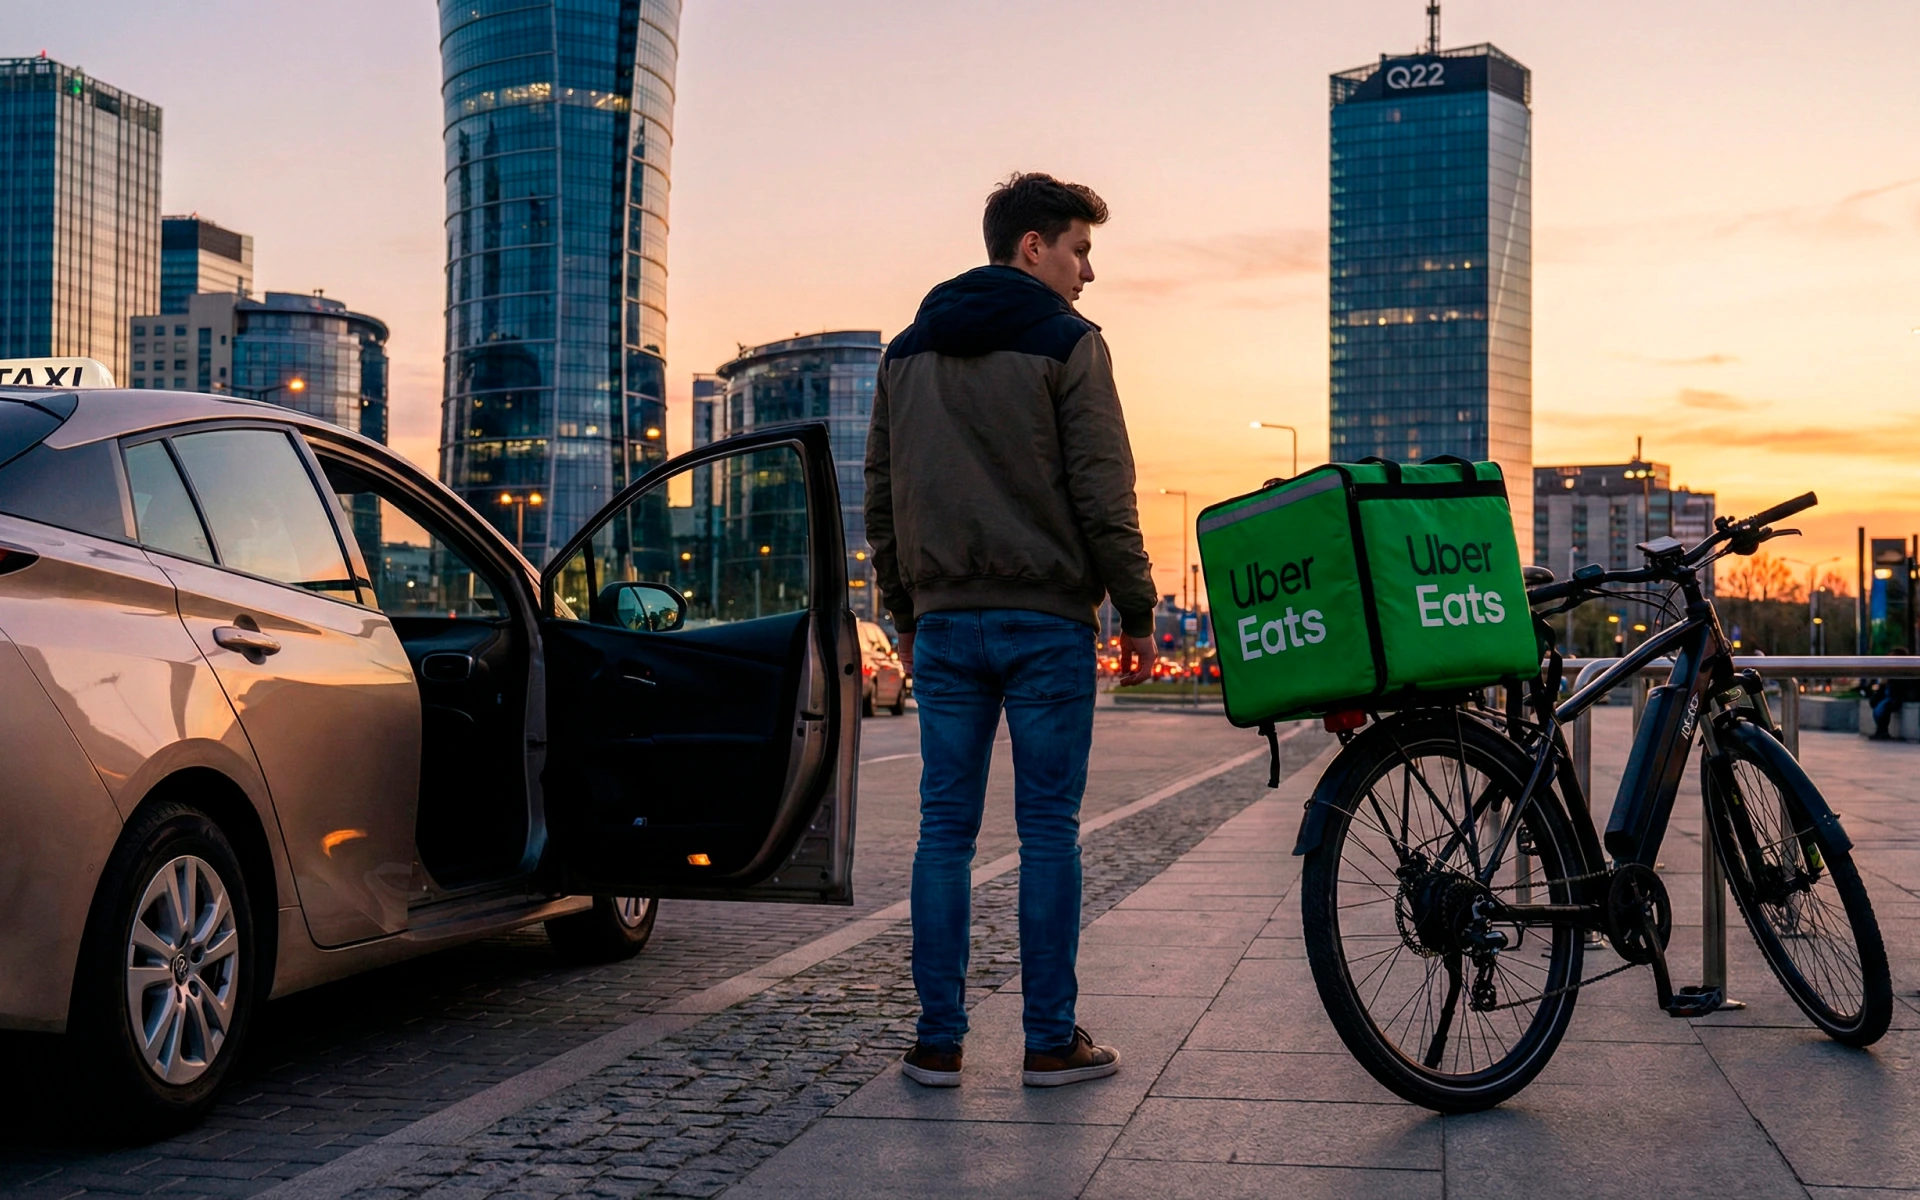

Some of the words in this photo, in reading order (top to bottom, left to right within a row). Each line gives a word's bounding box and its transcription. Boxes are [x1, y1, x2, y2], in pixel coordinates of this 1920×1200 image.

[1387, 63, 1444, 89] Q22
[1406, 534, 1492, 576] Uber
[1229, 556, 1314, 609] Uber
[1415, 584, 1505, 627] Eats
[1237, 607, 1327, 661] Eats
